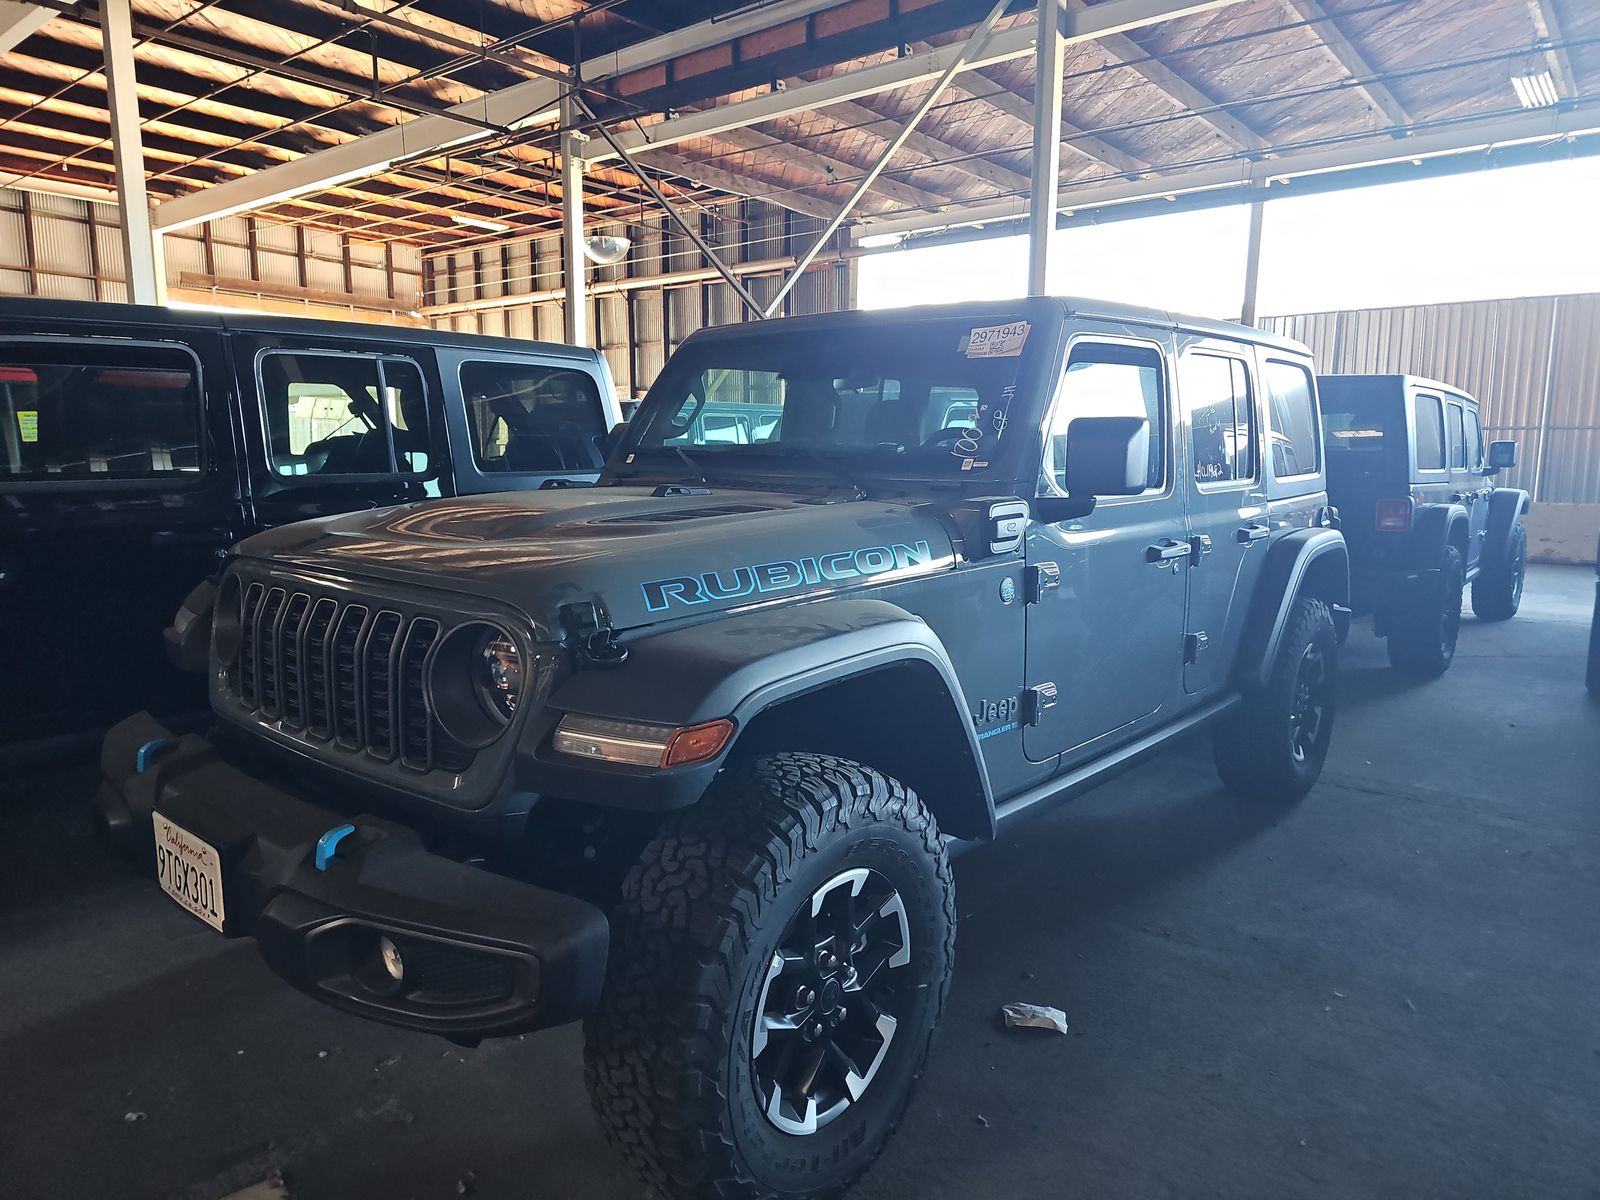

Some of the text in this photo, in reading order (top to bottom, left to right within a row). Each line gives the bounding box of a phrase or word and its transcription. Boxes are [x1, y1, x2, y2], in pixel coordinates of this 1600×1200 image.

[971, 324, 1026, 345] 2971943
[640, 540, 933, 612] RUBICON
[973, 696, 1018, 726] Jeep
[165, 826, 208, 866] California
[158, 844, 218, 918] 9TGX301
